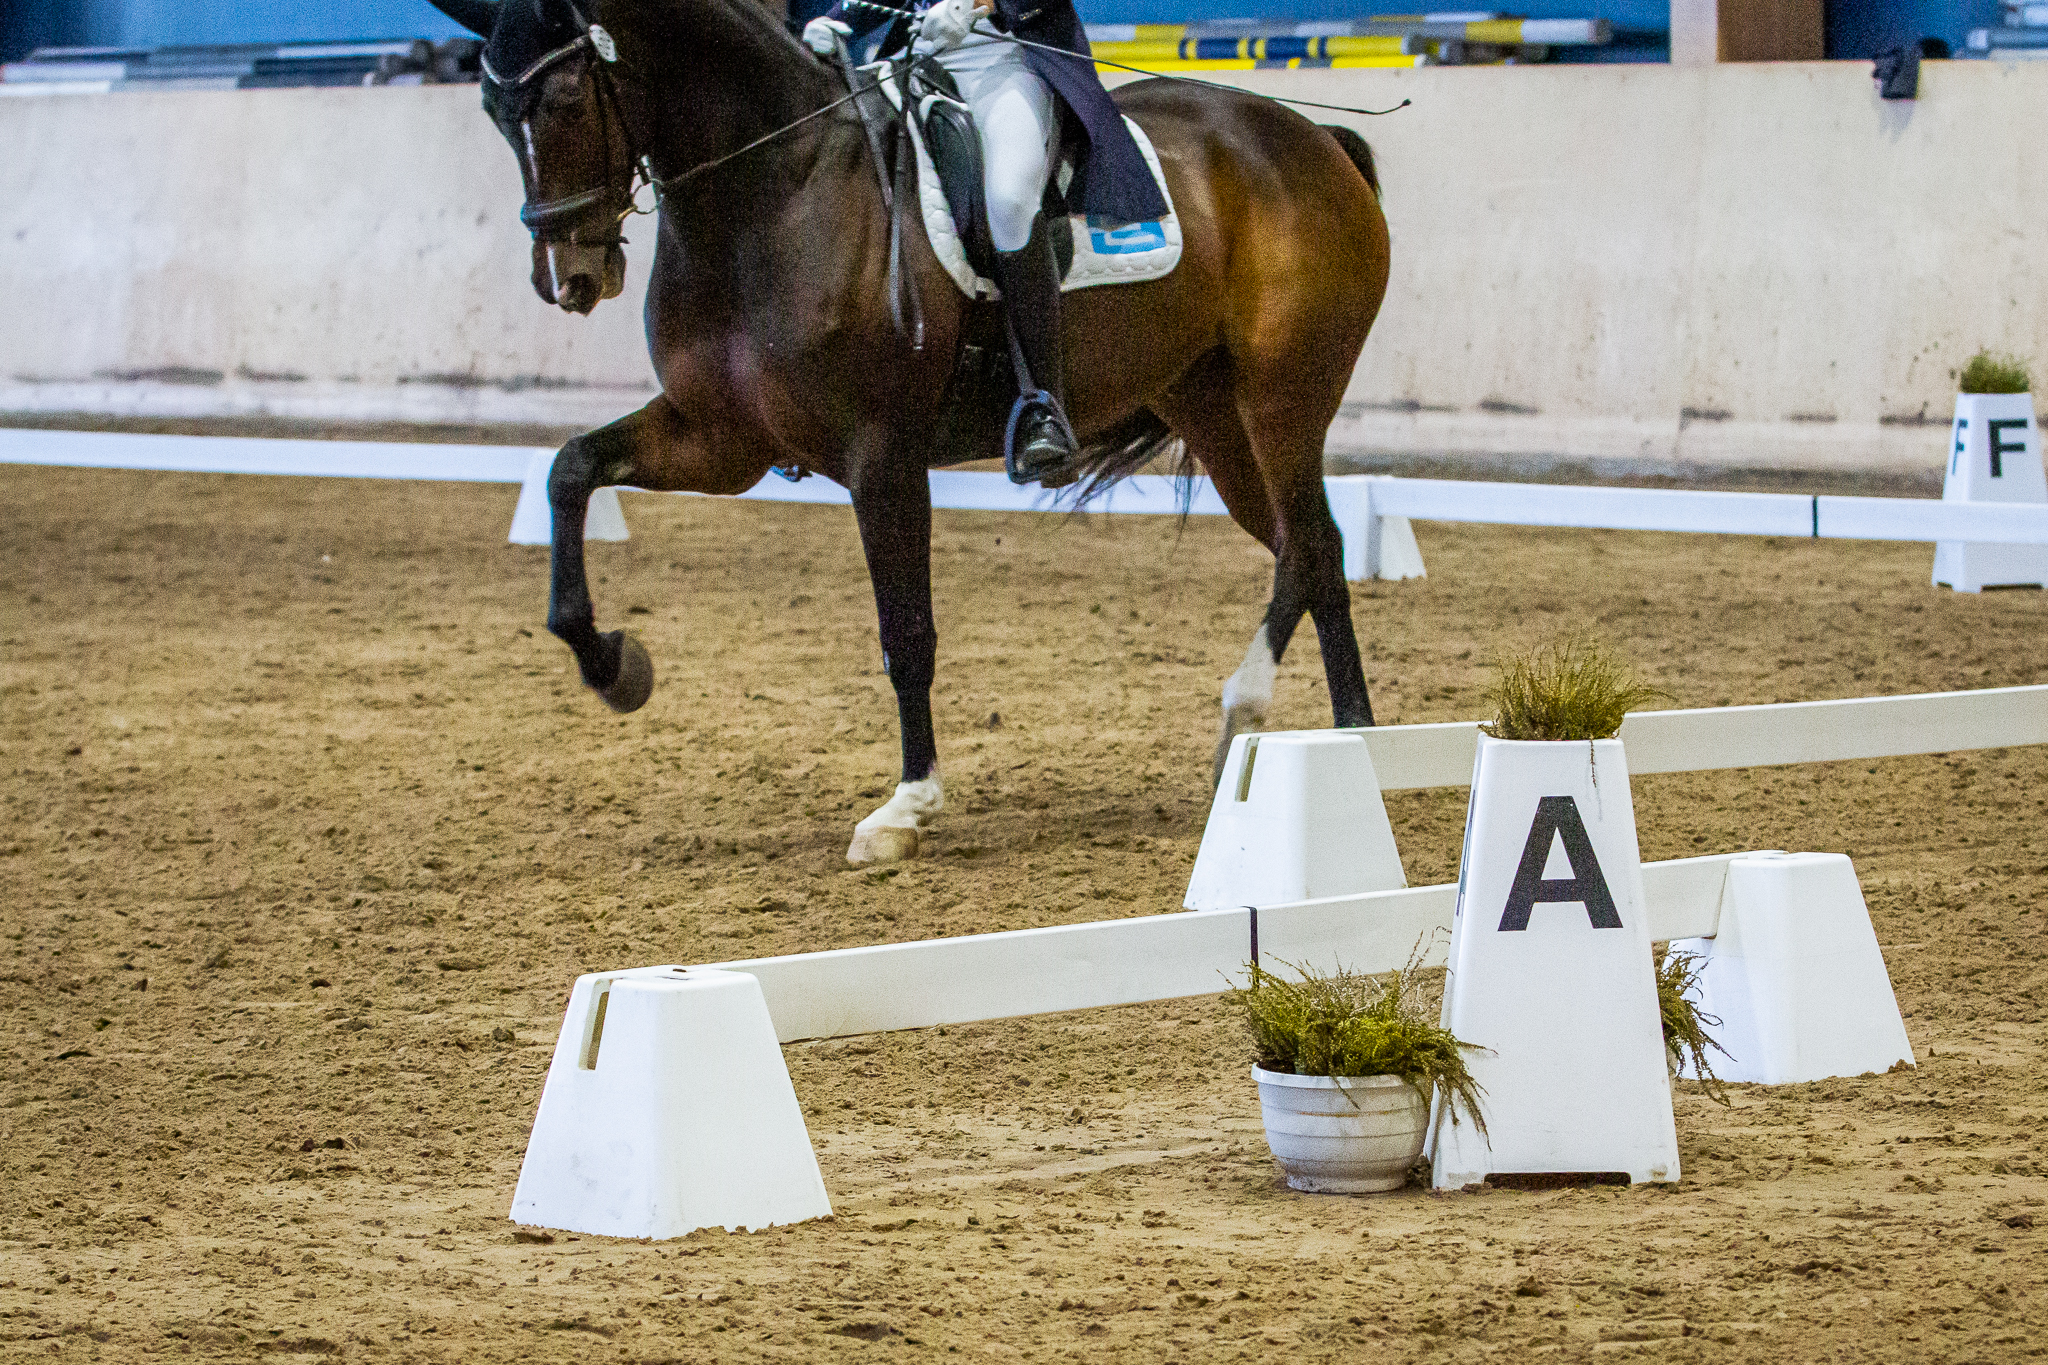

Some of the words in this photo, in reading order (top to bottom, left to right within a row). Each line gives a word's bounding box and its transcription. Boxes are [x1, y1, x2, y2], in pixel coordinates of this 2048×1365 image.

[1952, 419, 1968, 475] F
[1989, 418, 2028, 478] F
[1497, 795, 1624, 932] A
